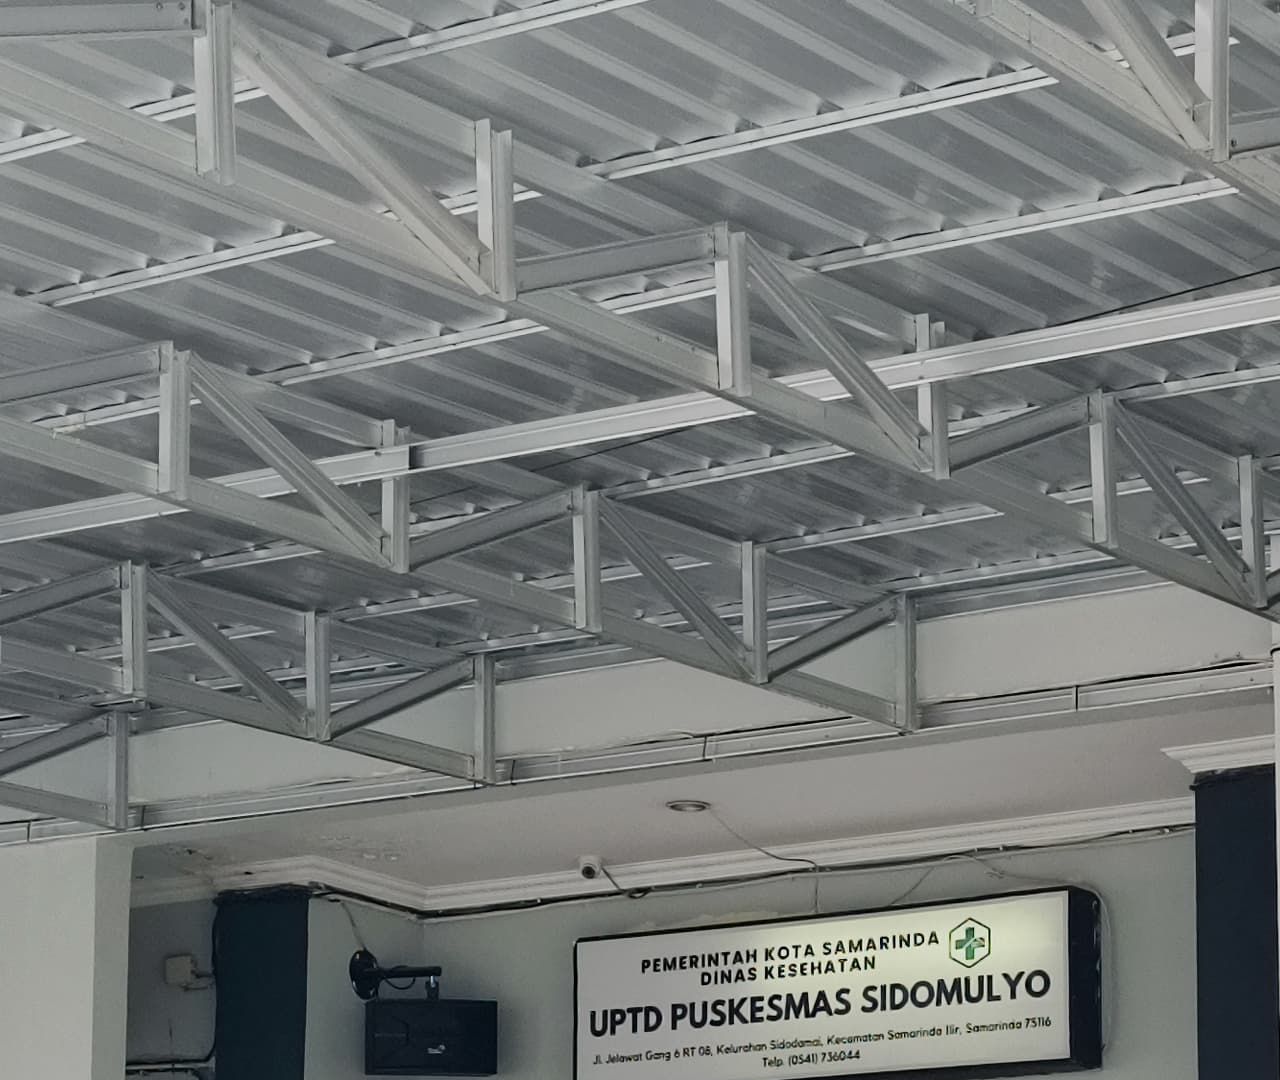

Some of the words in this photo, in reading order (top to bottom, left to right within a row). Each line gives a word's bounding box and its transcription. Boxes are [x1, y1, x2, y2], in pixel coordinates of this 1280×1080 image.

[642, 948, 758, 974] PEMERINTAH
[765, 943, 816, 962] KOTA
[822, 930, 940, 957] SAMARINDA
[700, 966, 758, 986] DINAS
[764, 956, 876, 980] KESEHATAN
[589, 1004, 663, 1038] UPTD
[670, 988, 852, 1030] PUSKESMAS
[861, 969, 1052, 1013] SIDOMULYO
[606, 1052, 643, 1064] Jelawat
[646, 1050, 671, 1063] Gang
[674, 1048, 680, 1058] 6
[683, 1047, 695, 1058] RT
[716, 1042, 768, 1055] Kelurahan
[827, 1032, 884, 1046] Kecamatan
[888, 1026, 942, 1040] Samarinda
[966, 1020, 1022, 1034] Samarinda
[788, 1054, 818, 1067] (0541)
[821, 1050, 861, 1063] 736044
